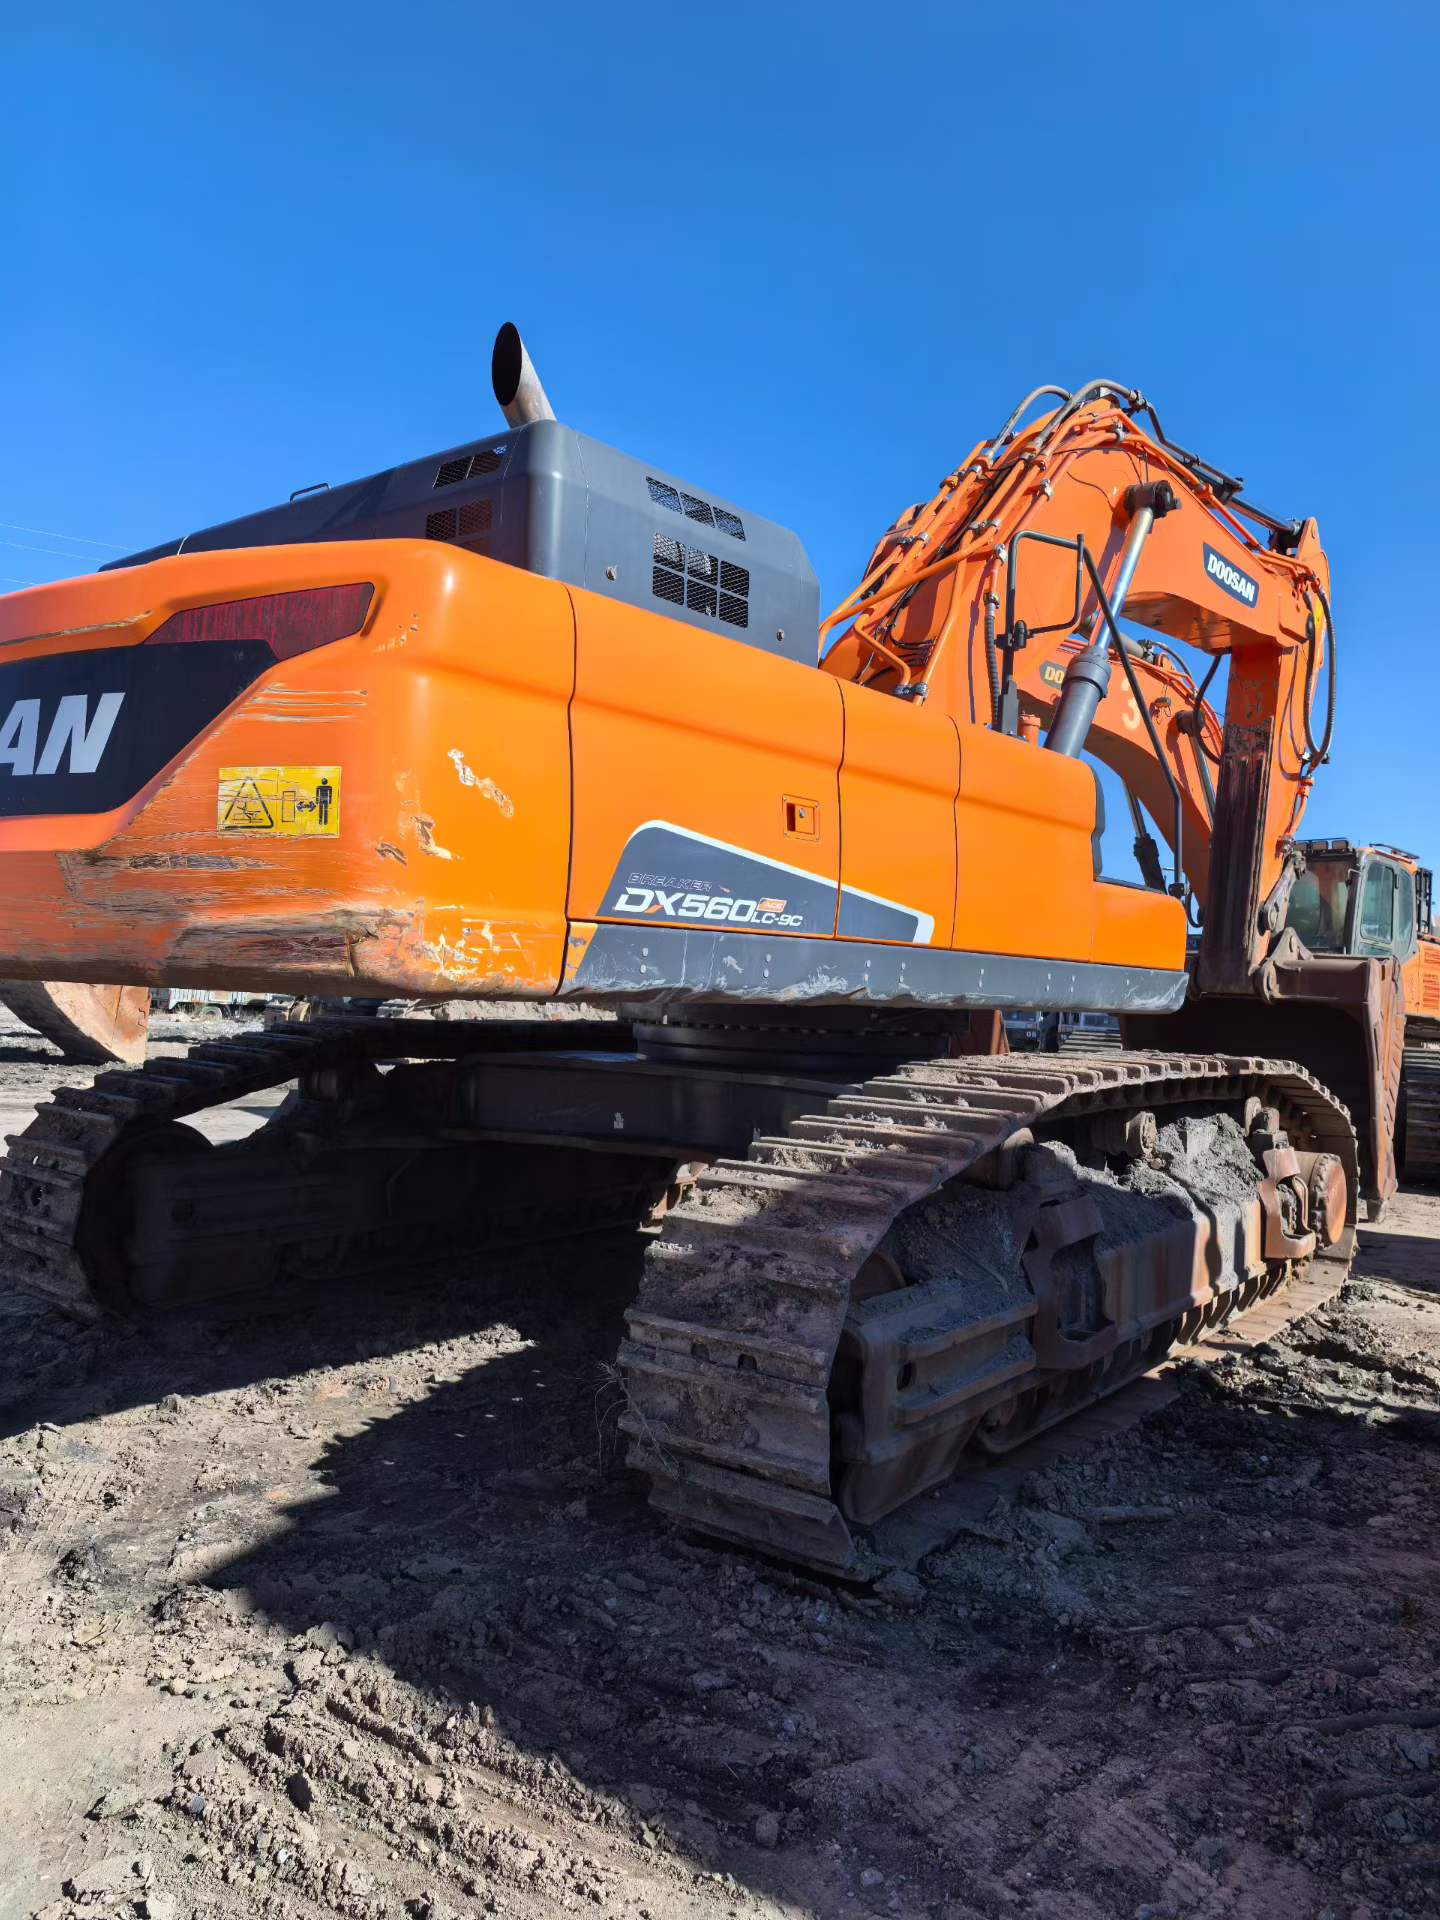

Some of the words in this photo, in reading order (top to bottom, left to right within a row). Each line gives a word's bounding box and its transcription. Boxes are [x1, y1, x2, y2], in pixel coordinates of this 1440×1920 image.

[1207, 553, 1256, 602] DOOSAN
[0, 692, 126, 776] AN
[627, 872, 713, 893] BREAKER
